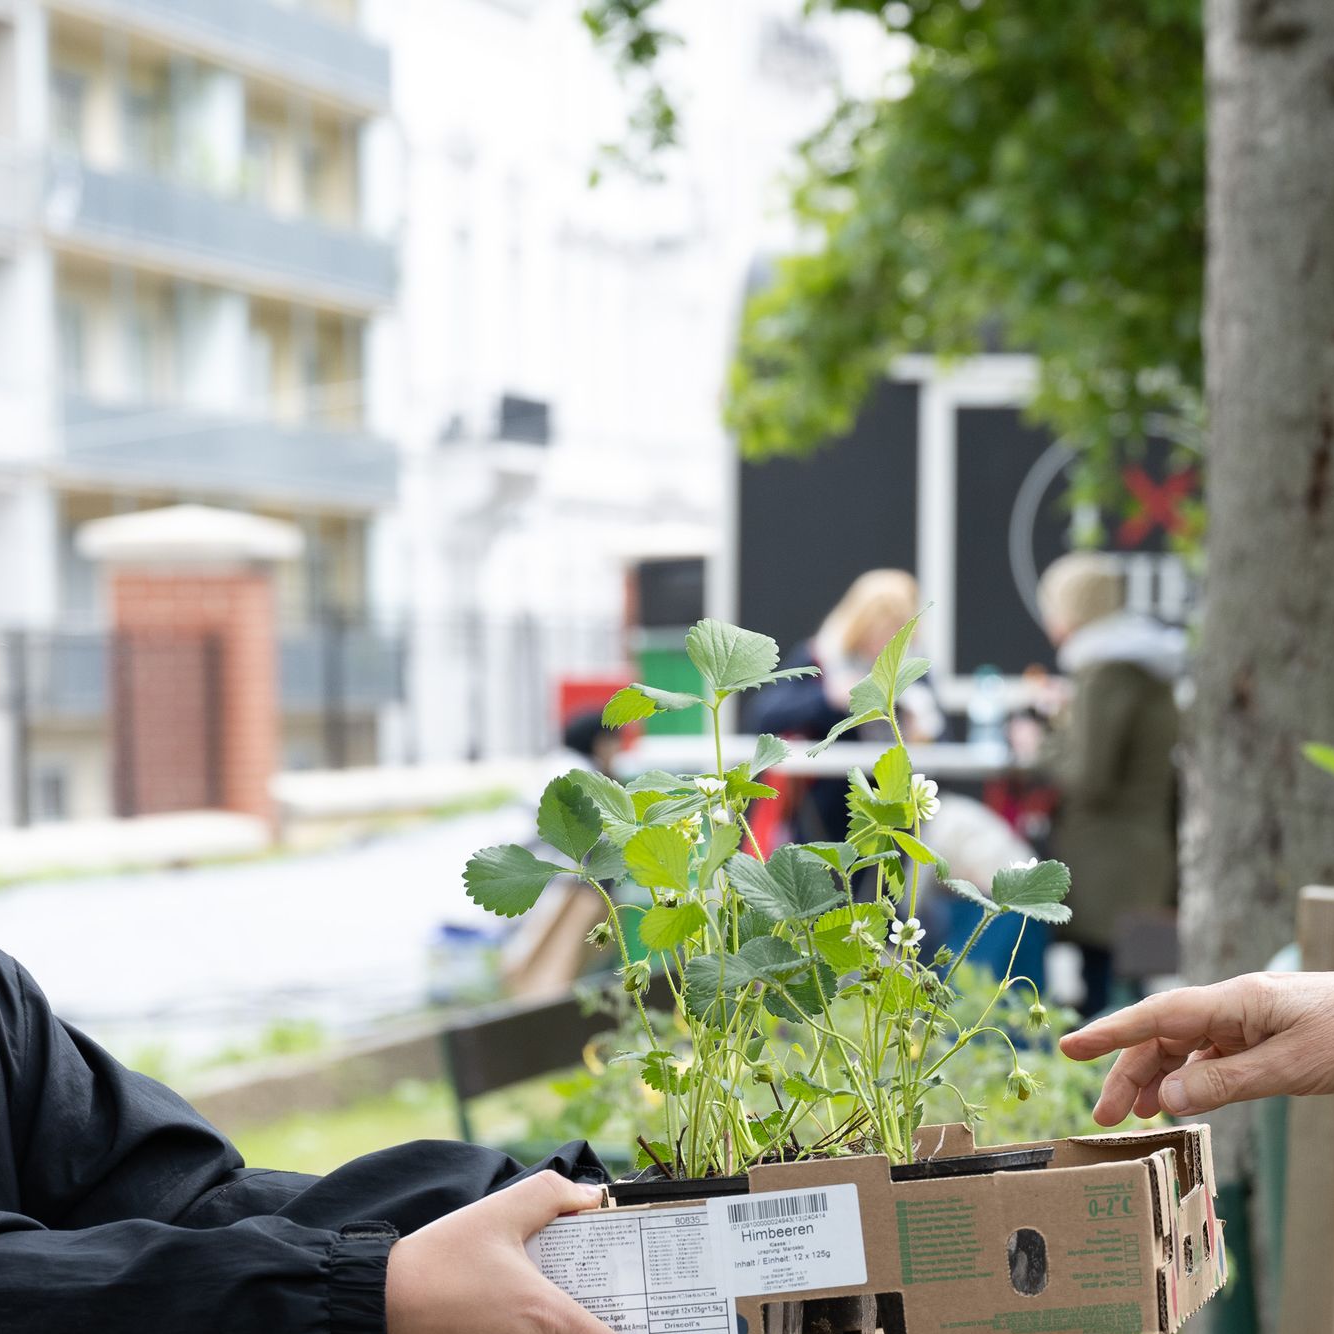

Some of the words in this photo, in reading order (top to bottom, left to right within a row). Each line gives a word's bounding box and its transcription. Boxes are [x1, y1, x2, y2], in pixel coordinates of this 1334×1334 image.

[675, 1216, 701, 1225] 80835
[741, 1224, 814, 1243] Himbeeren
[734, 1259, 756, 1270] Inhalt
[794, 1252, 803, 1262] 12
[812, 1249, 831, 1260] 125g
[649, 1309, 659, 1317] Net
[661, 1308, 679, 1317] weight
[664, 1321, 700, 1330] Driscoll's
